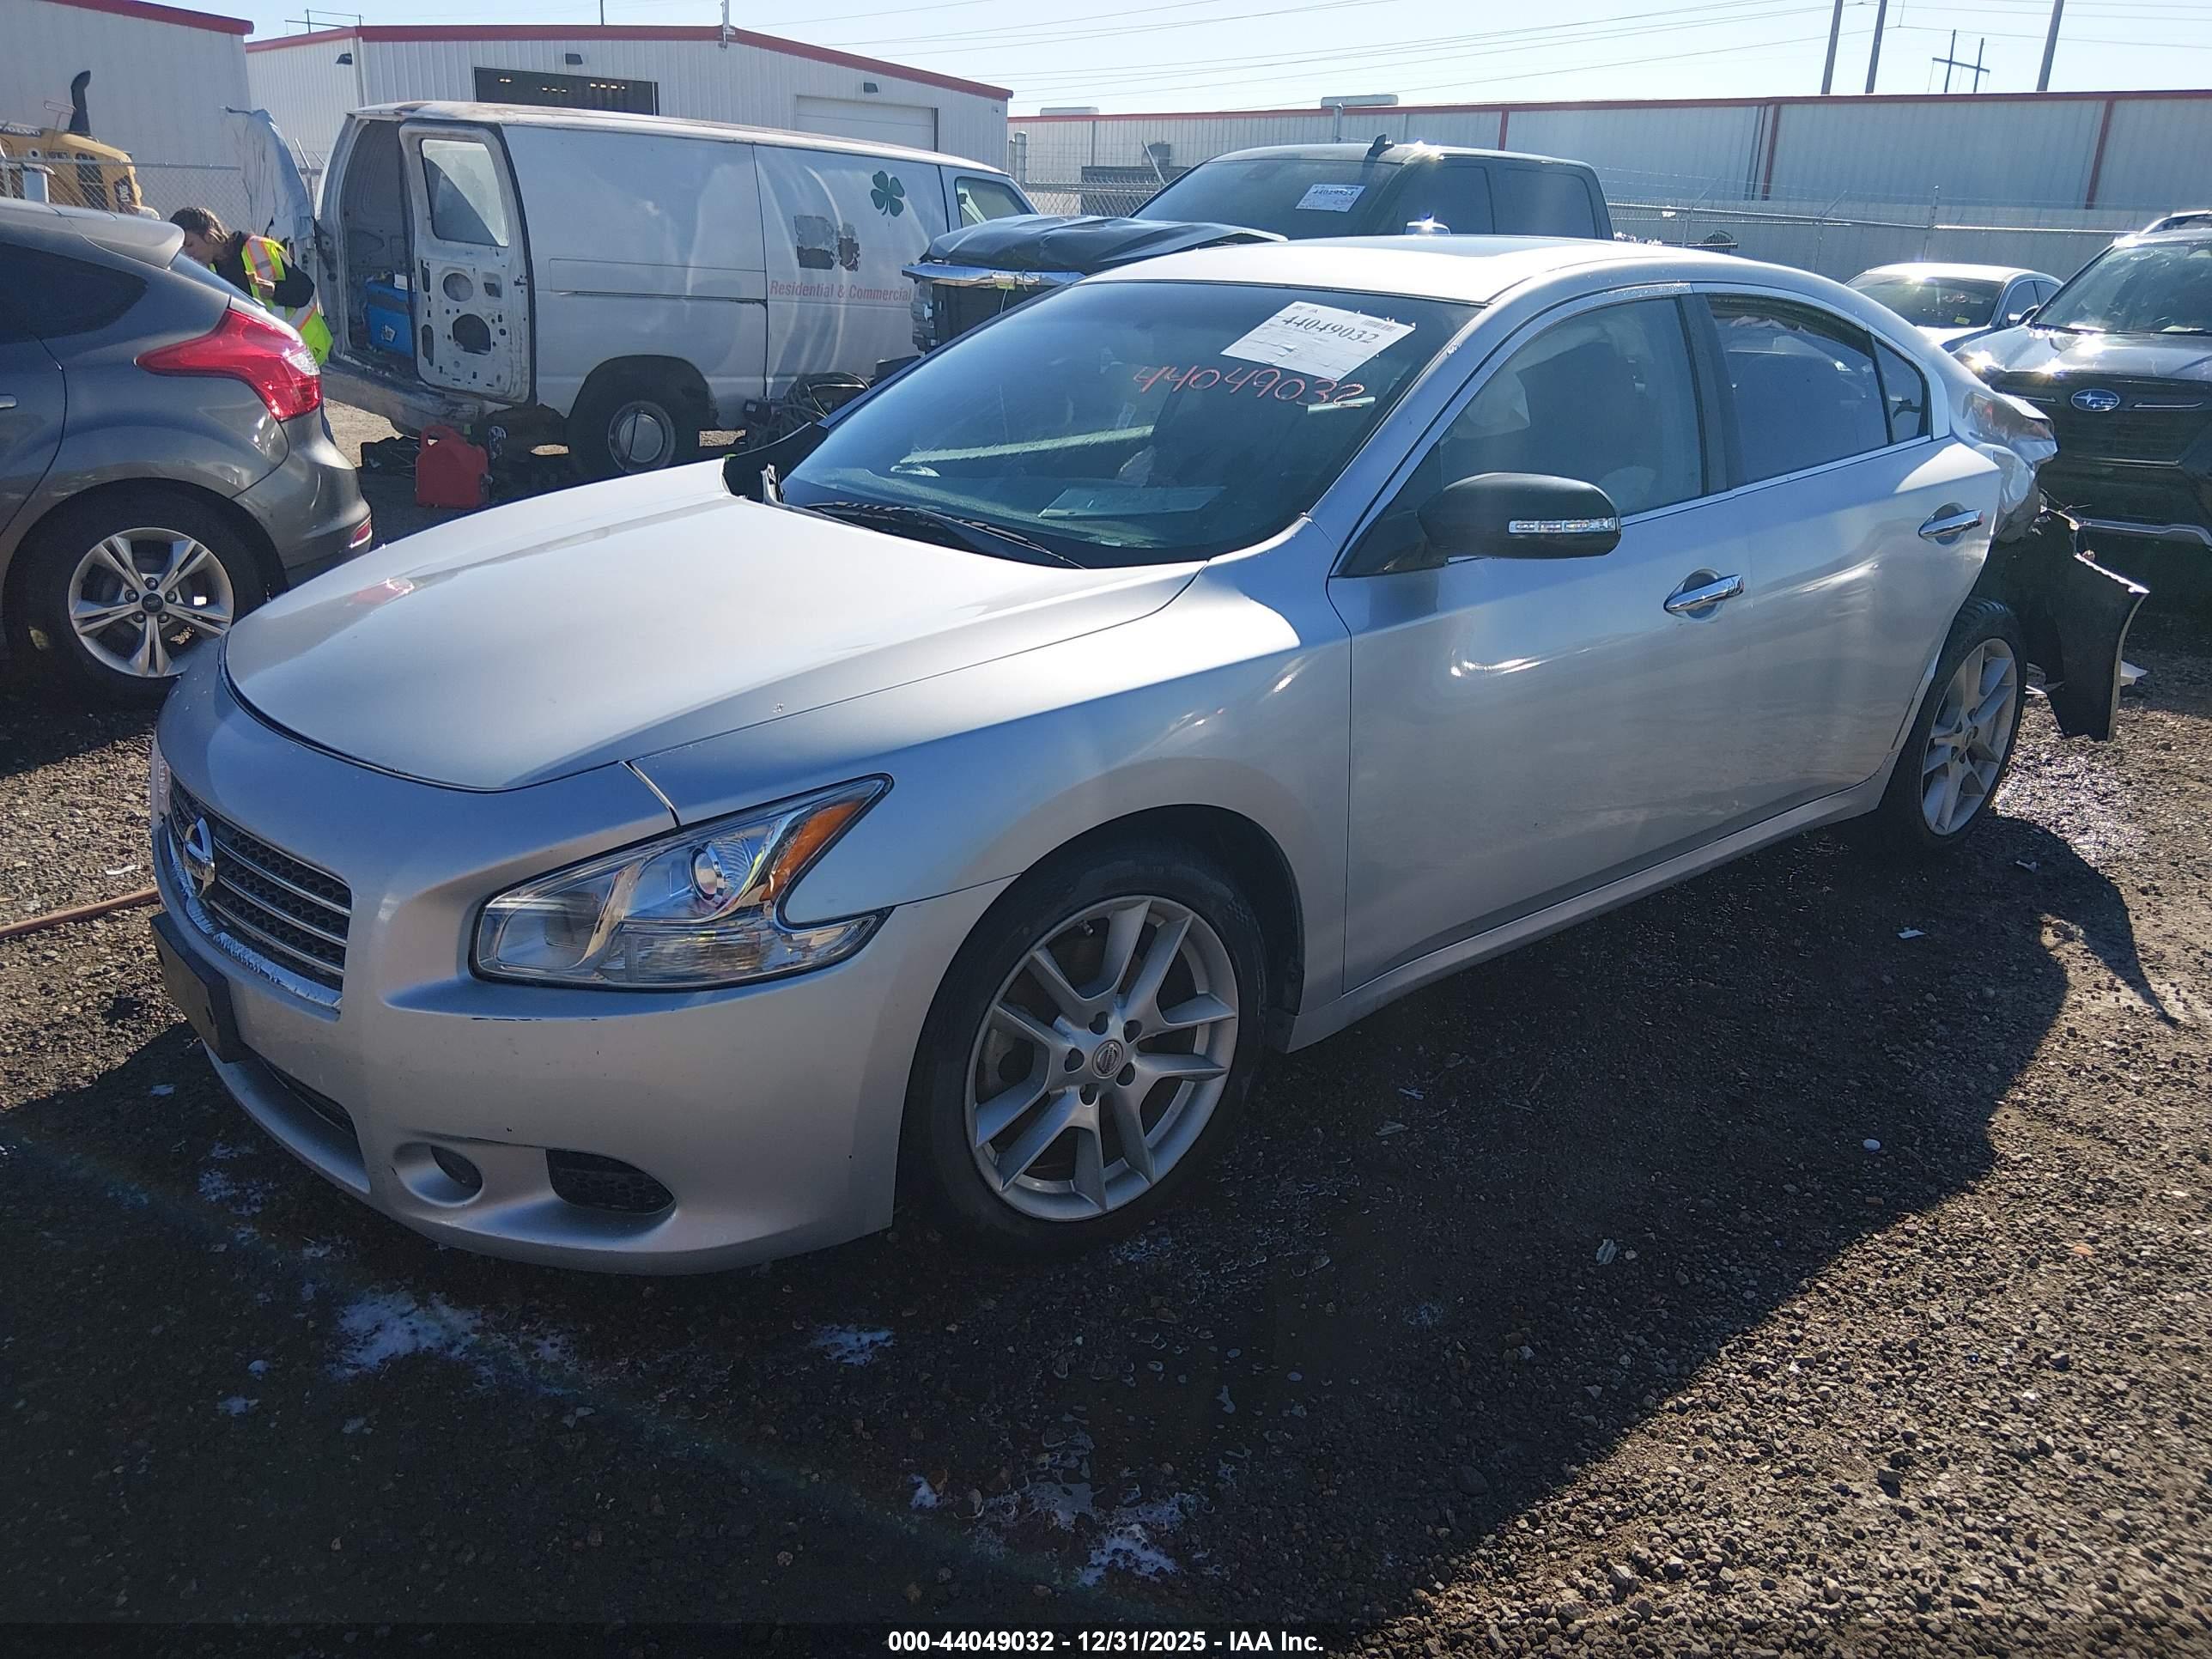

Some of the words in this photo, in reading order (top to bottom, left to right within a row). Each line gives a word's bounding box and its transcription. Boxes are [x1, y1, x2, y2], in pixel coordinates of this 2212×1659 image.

[769, 280, 834, 296] Residential
[837, 285, 846, 298] &
[848, 284, 912, 301] Commercial
[1282, 315, 1379, 343] 44049032
[1133, 365, 1365, 408] 44049032
